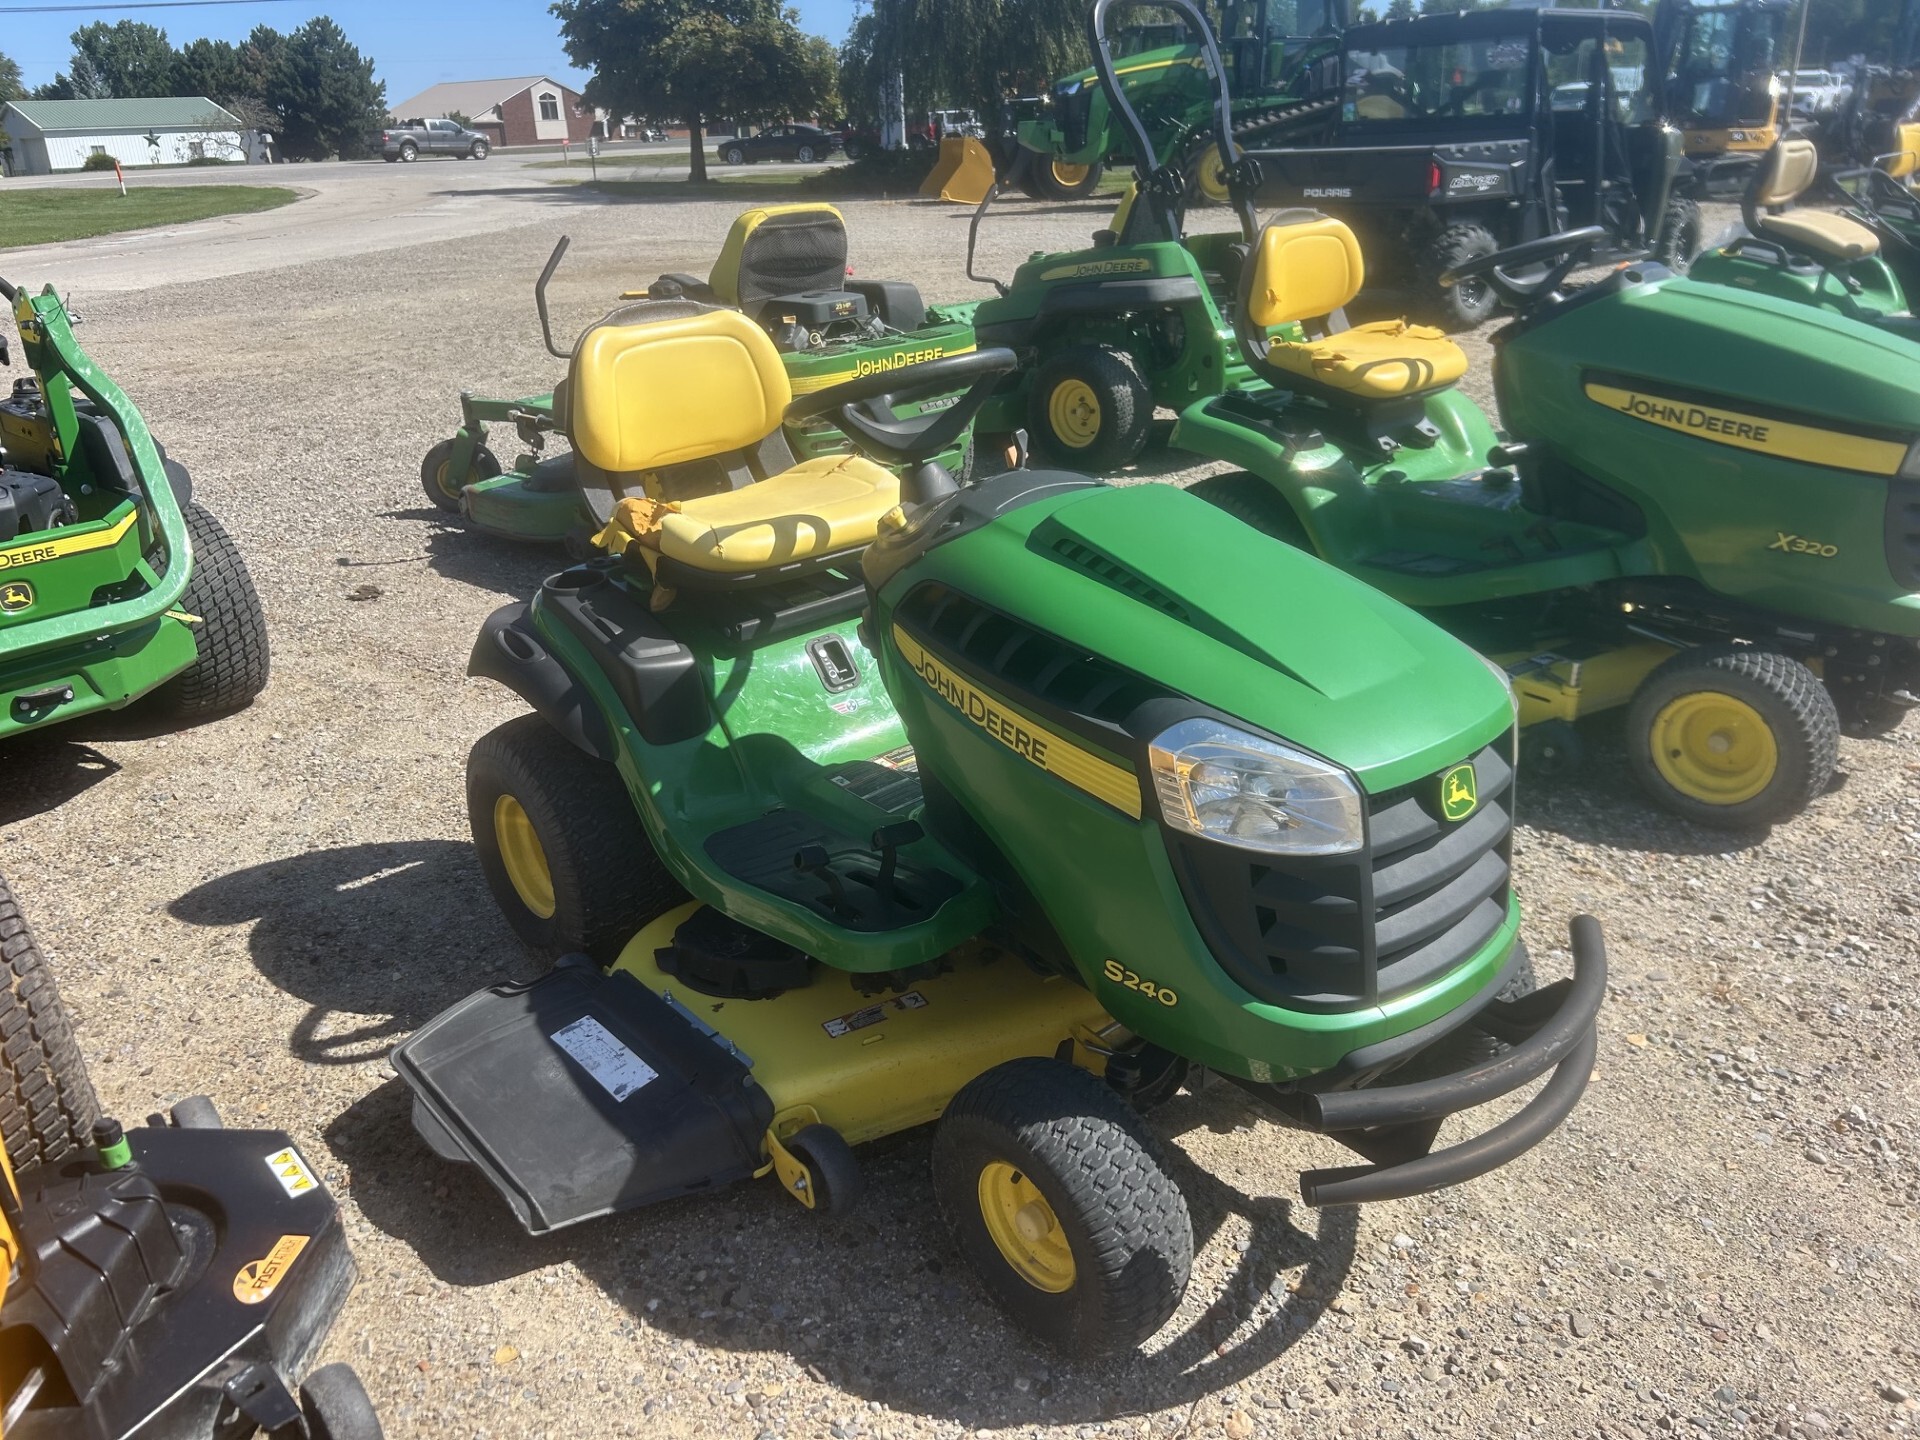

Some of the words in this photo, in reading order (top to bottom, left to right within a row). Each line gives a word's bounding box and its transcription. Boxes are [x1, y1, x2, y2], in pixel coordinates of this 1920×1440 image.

[1303, 187, 1352, 198] POLARIS
[1073, 264, 1103, 277] JOHN
[1104, 261, 1143, 273] DEERE
[851, 358, 893, 378] JOHN
[895, 347, 944, 368] DEERE
[1620, 394, 1685, 424] JOHN
[1687, 408, 1769, 443] DEERE
[0, 546, 57, 567] DEERE
[1766, 531, 1838, 557] X320
[915, 650, 965, 710] JOHN
[968, 690, 1048, 767] DEERE
[1103, 959, 1178, 1007] S240
